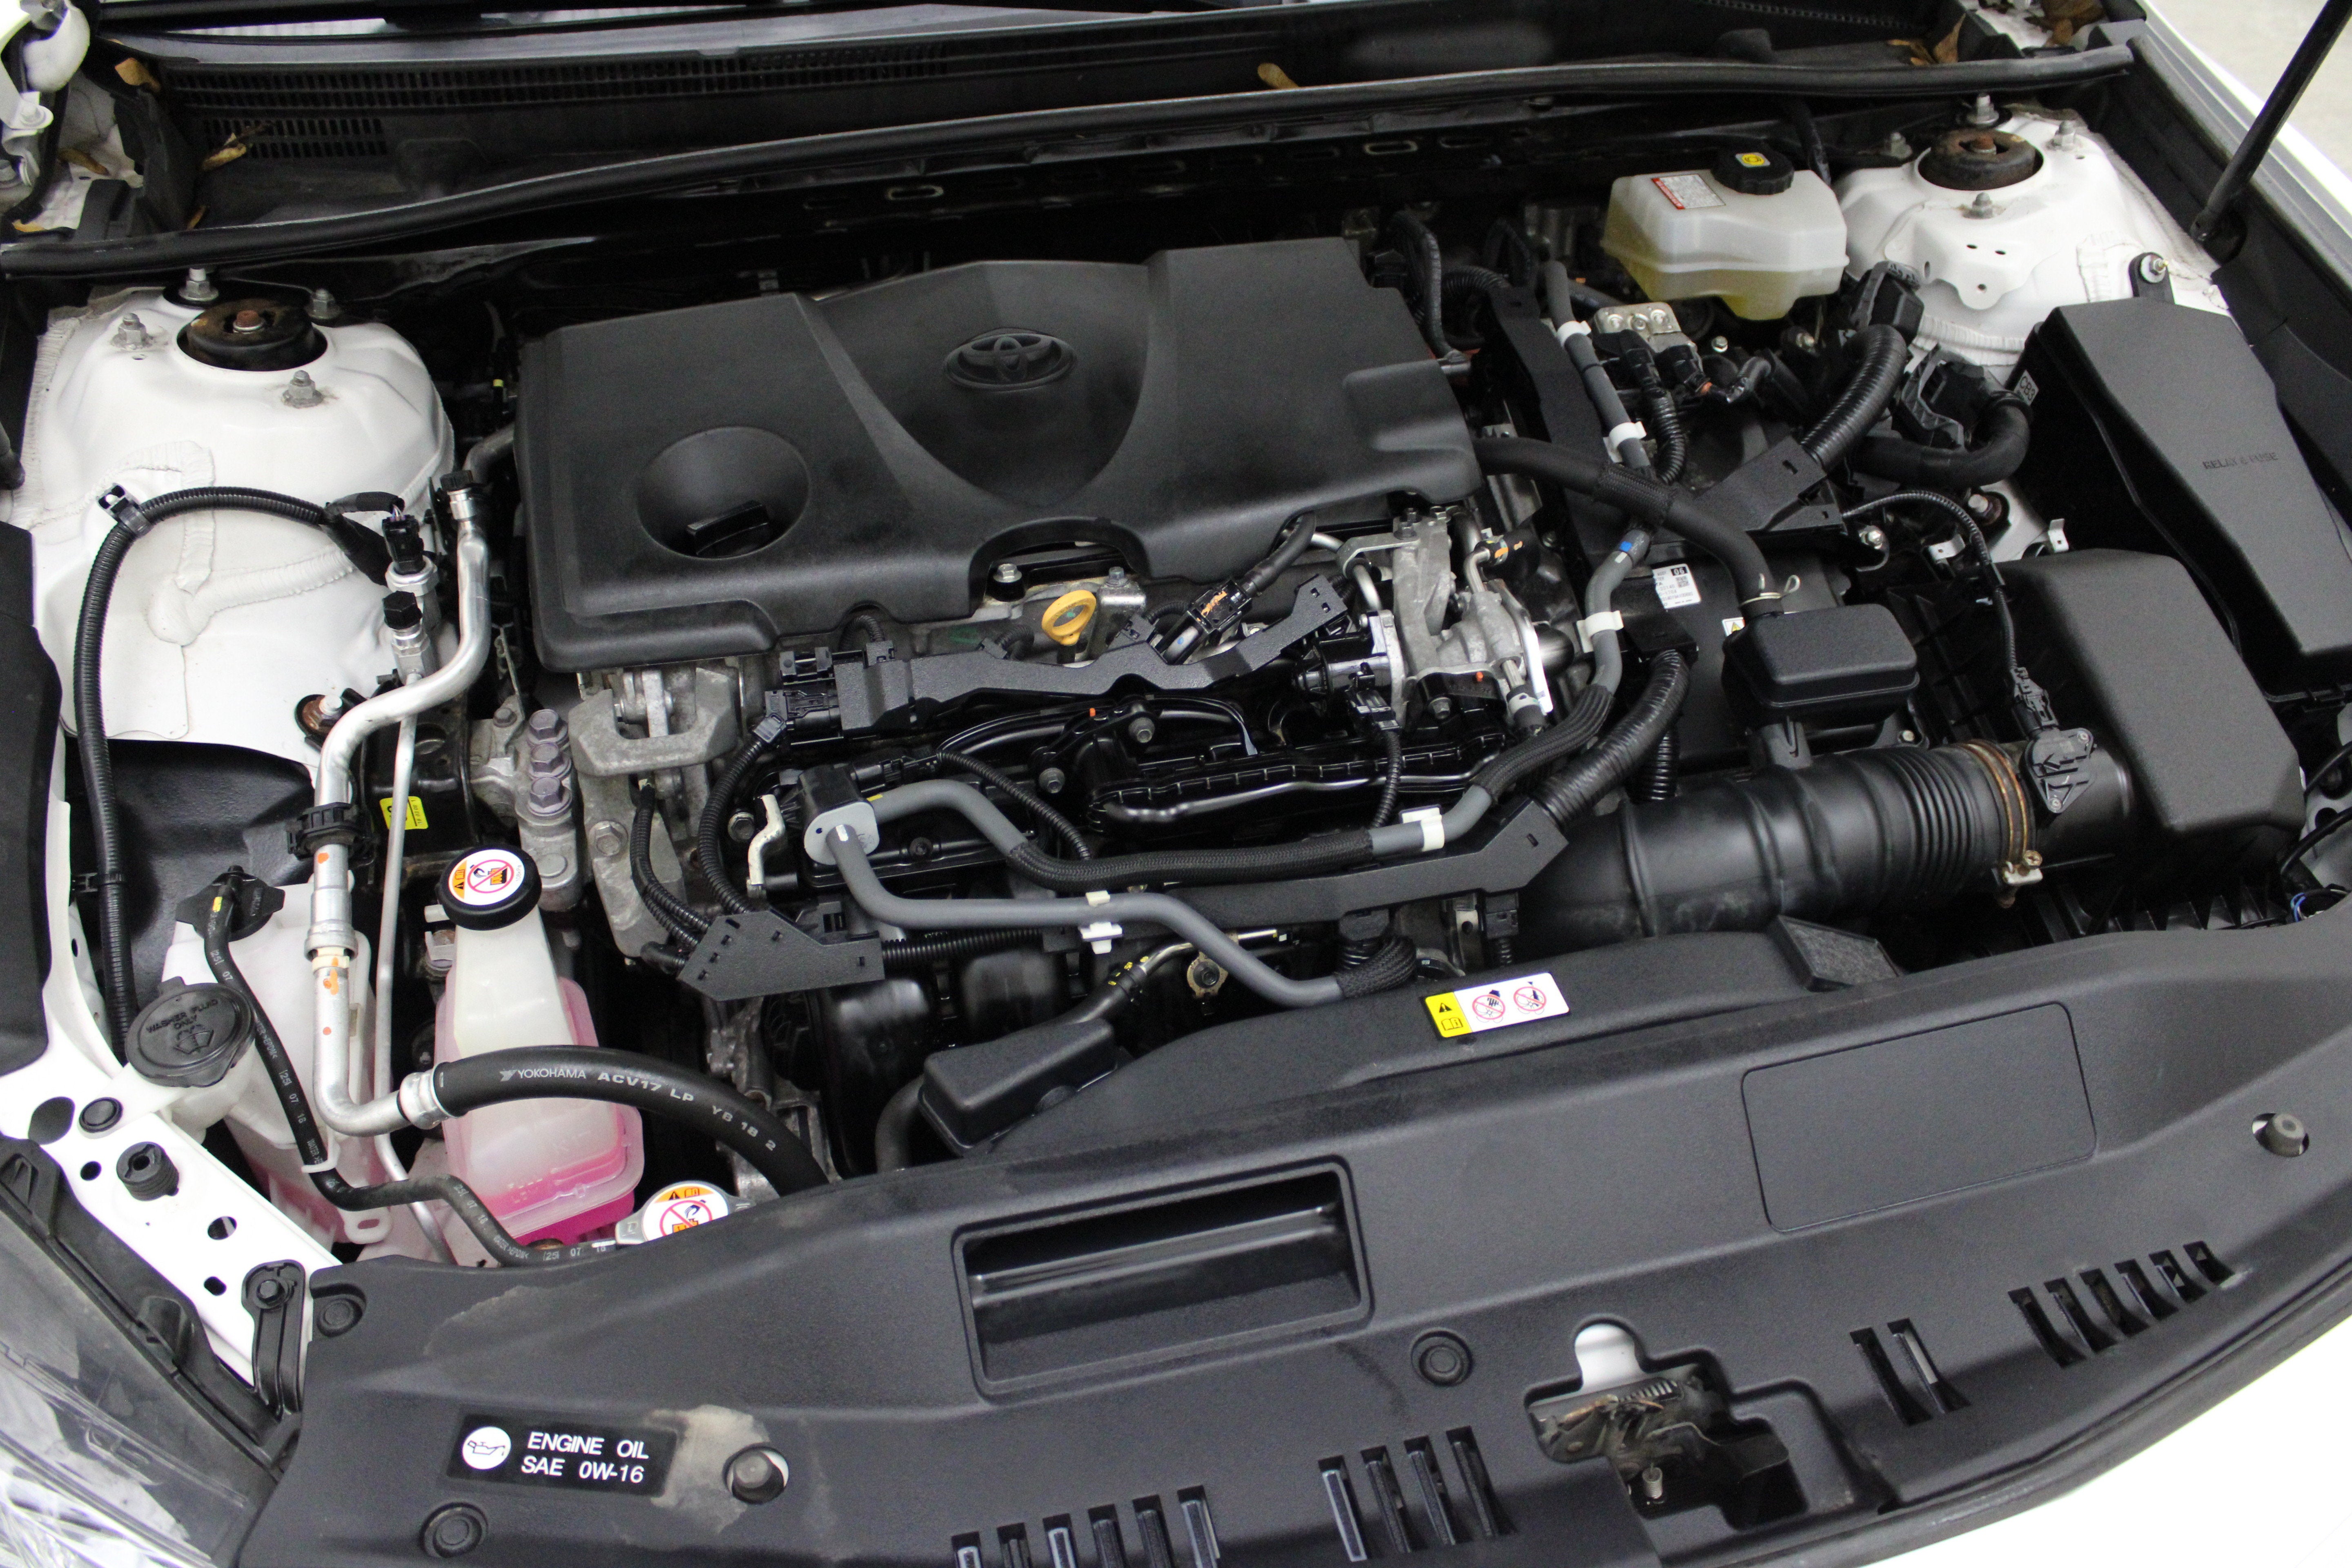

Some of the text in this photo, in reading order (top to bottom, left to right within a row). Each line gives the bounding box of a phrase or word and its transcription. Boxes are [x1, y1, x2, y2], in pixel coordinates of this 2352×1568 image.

[2020, 376, 2035, 401] CB3
[1674, 567, 1685, 575] 06
[222, 971, 234, 981] 07
[146, 999, 218, 1033] WASHER FLUID
[174, 1014, 198, 1030] ONLY
[517, 1068, 587, 1079] YOKOHAMA
[597, 1072, 662, 1091] ACV17
[670, 1089, 694, 1101] LP
[765, 1139, 776, 1151] 2
[289, 1093, 299, 1103] 07
[307, 1139, 319, 1157] WATER
[570, 1247, 581, 1257] 07
[527, 1431, 649, 1459] ENGINE OIL
[521, 1455, 645, 1483] SAE 0W-16
